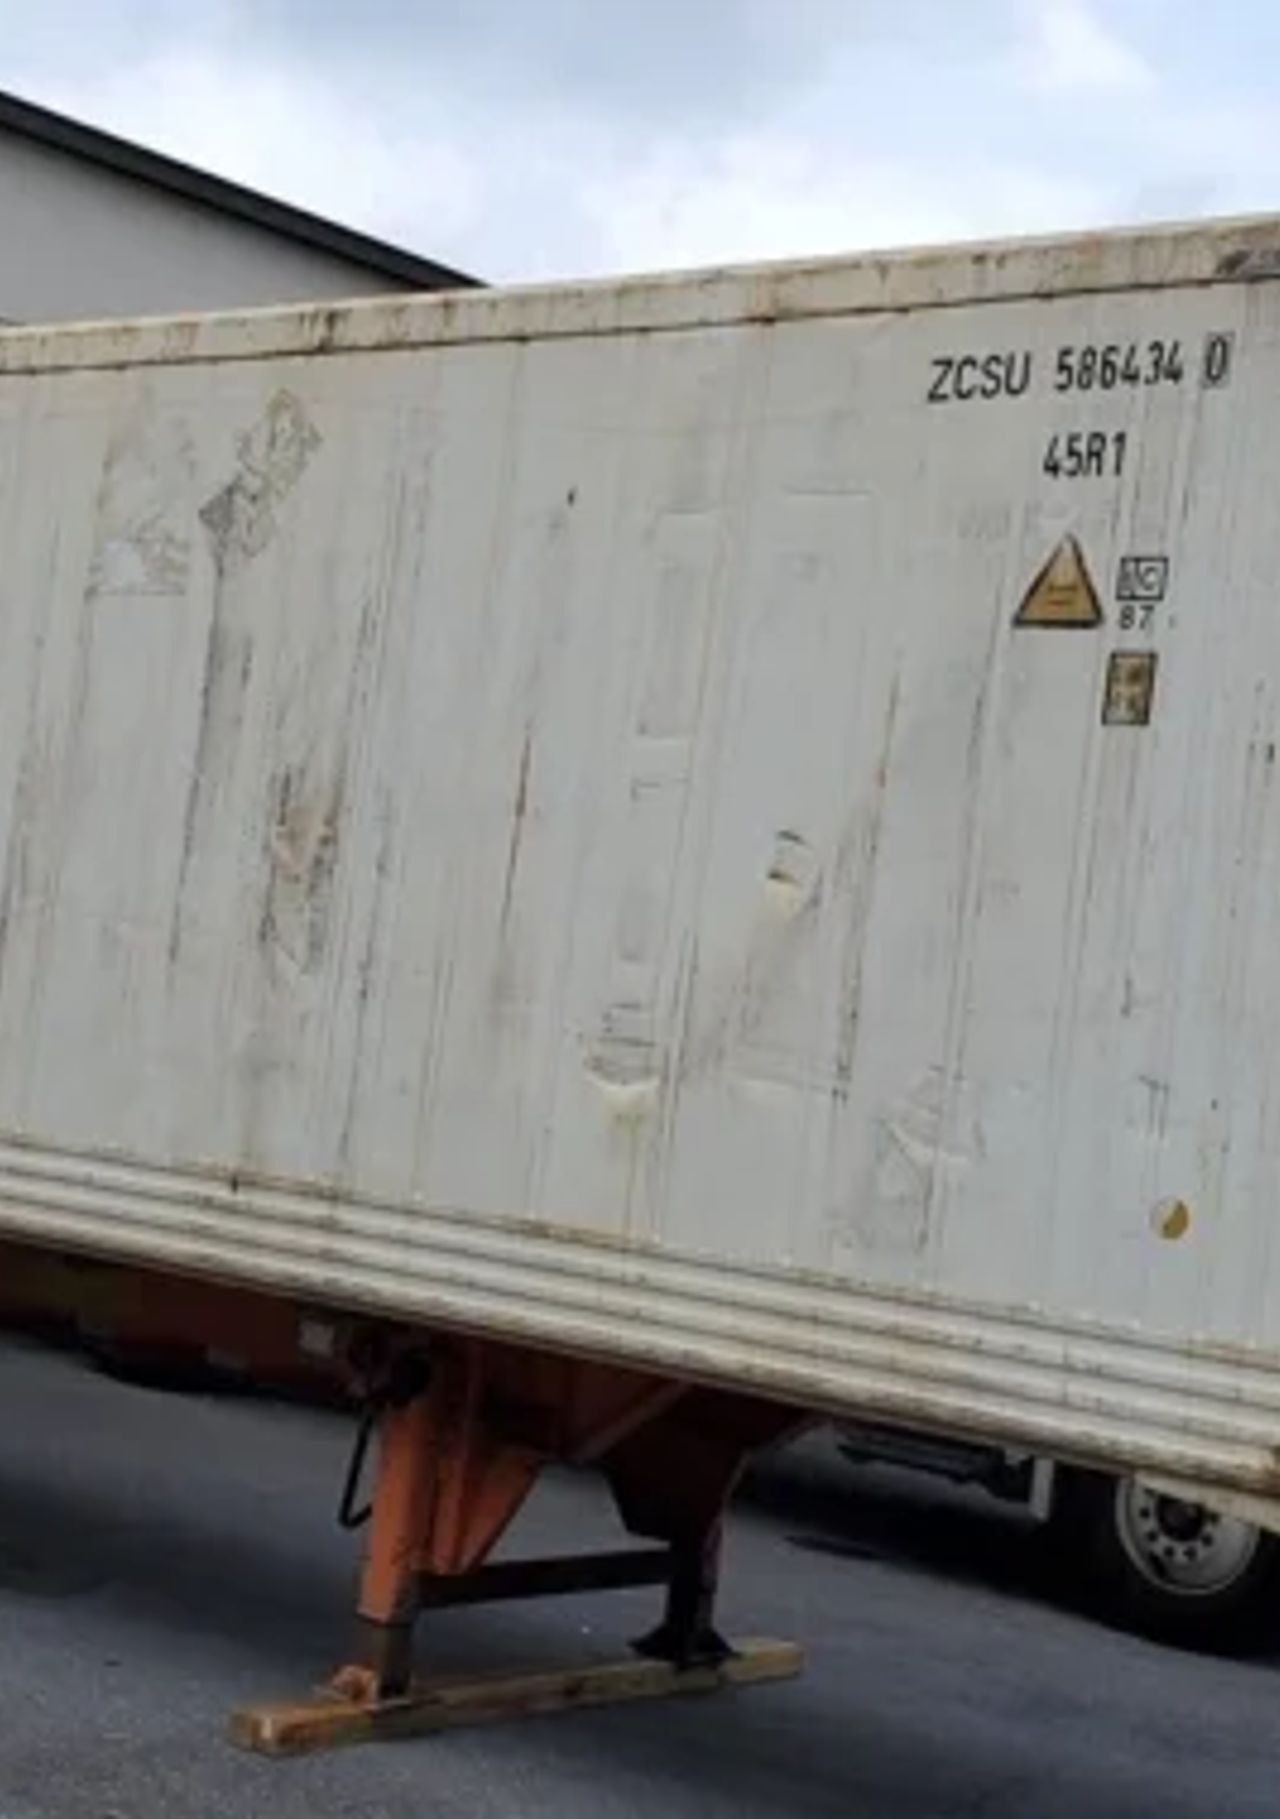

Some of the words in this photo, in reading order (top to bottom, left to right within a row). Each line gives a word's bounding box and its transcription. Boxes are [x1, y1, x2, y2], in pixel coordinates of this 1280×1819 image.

[927, 352, 1032, 403] ZCSU
[1053, 340, 1184, 392] 586434
[1203, 333, 1230, 386] 0
[1042, 430, 1126, 479] 45R1
[1120, 604, 1154, 630] 87
